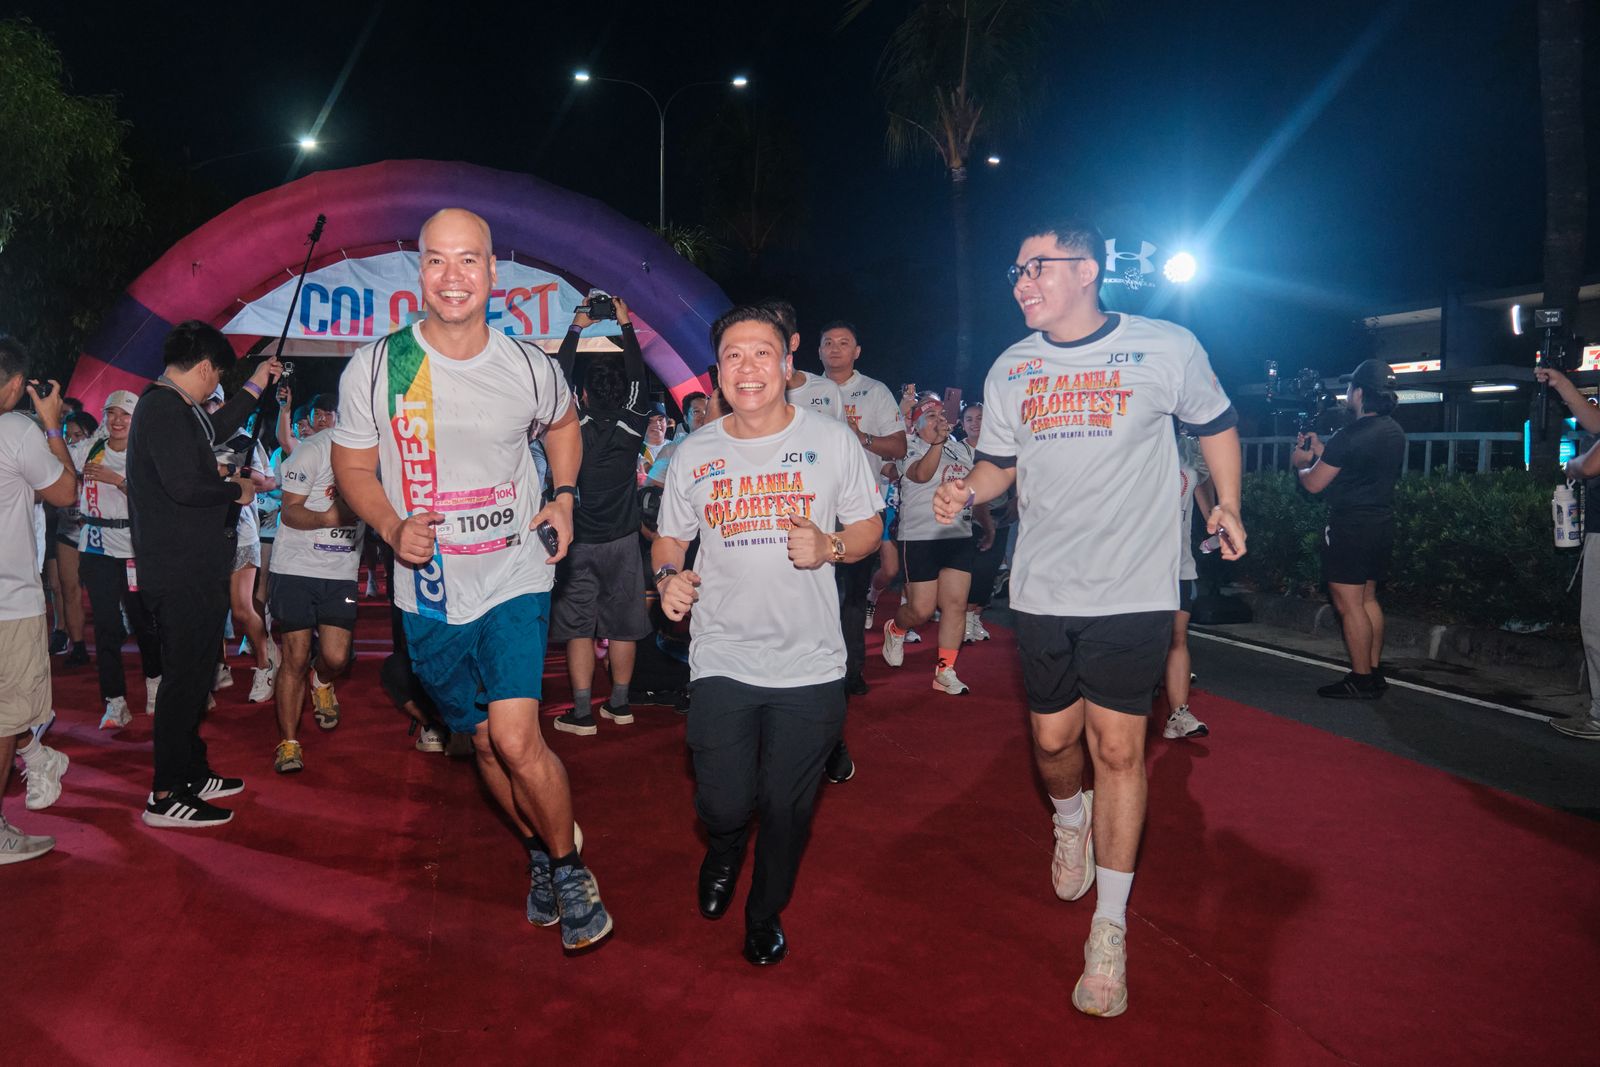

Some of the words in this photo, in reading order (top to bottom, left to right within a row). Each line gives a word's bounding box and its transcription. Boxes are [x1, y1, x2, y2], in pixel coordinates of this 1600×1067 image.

[1107, 353, 1129, 364] JCI
[1025, 375, 1050, 396] JCI
[1053, 369, 1121, 392] MANILA
[1021, 388, 1134, 424] COLORFEST
[1030, 413, 1085, 434] CARNIVAL
[1088, 413, 1113, 429] RUN
[1060, 431, 1085, 439] MENTAL
[1088, 429, 1113, 437] HEALTH
[781, 452, 803, 463] JCI
[285, 471, 298, 481] JCI
[710, 478, 734, 500] JCI
[738, 471, 805, 497] MANILA
[495, 488, 513, 500] 10K
[457, 507, 515, 534] 11009
[704, 493, 816, 529] COLORFEST
[720, 518, 774, 539] CARNIVAL
[724, 539, 735, 548] RUN
[737, 539, 749, 547] FOR
[751, 537, 776, 546] MENTAL
